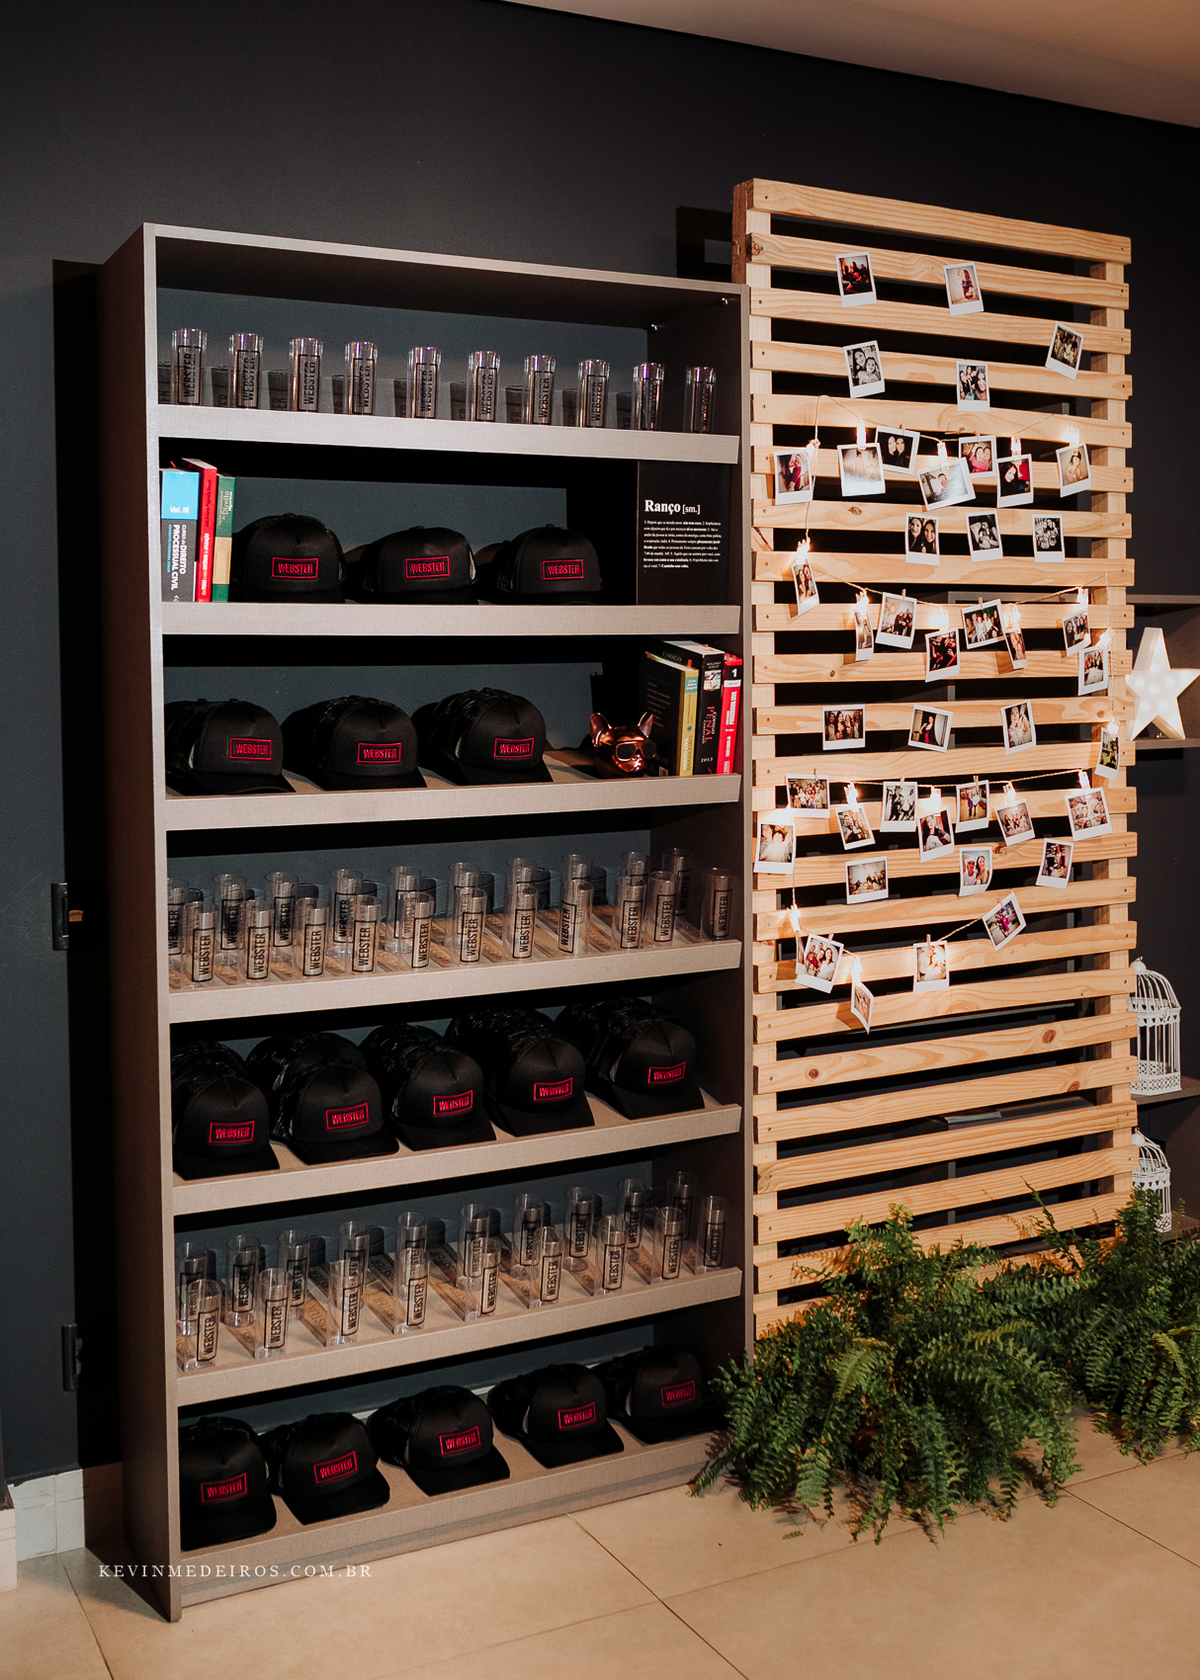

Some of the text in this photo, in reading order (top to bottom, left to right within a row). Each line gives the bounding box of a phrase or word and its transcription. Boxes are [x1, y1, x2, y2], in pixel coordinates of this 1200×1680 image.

[183, 352, 196, 398] WEBSTER
[243, 357, 255, 401] WEBSTER
[303, 361, 316, 405] WEBSTER
[421, 370, 433, 412] WEBSTER
[644, 499, 701, 516] Ranço [sm.]
[171, 524, 180, 591] PROCESSUAL CIVIL
[179, 545, 187, 575] DIREITO
[278, 563, 313, 574] WEBSTER
[411, 561, 446, 574] WEBSTER
[548, 563, 581, 575] WEBSTER
[732, 668, 738, 678] 1
[704, 706, 715, 743] PENAL
[235, 743, 268, 755] WEBSTER
[363, 748, 397, 760] WEBSTER
[499, 743, 530, 755] WEBSTER
[279, 901, 292, 942] WEBSTER
[561, 907, 571, 946] WEBSTER
[626, 905, 639, 943] WEBSTER
[660, 900, 672, 937] WEBSTER
[718, 895, 729, 933] WEBSTER
[310, 929, 322, 970] WEBSTER
[358, 927, 371, 967] WEBSTER
[418, 922, 430, 962] WEBSTER
[466, 917, 479, 957] WEBSTER
[519, 914, 531, 953] WEBSTER
[199, 934, 211, 976] WEBSTER
[253, 932, 266, 974] WEBSTER
[539, 1083, 570, 1098] WEBSTER
[653, 1067, 682, 1081] WEBSTER
[331, 1109, 365, 1125] WEBSTER
[439, 1095, 470, 1111] WEBSTER
[215, 1126, 250, 1139] WEBSTER
[575, 1219, 587, 1253] WEBSTER
[609, 1250, 621, 1285] WEBSTER
[668, 1240, 679, 1274] WEBSTER
[291, 1266, 304, 1303] WEBSTER
[487, 1272, 497, 1308] WEBSTER
[547, 1260, 559, 1296] WEBSTER
[348, 1289, 358, 1330] WEBSTER
[413, 1283, 424, 1320] WEBSTER
[203, 1315, 216, 1355] WEBSTER
[270, 1305, 283, 1343] WEBSTER
[665, 1386, 694, 1401] WEBSTER
[563, 1408, 593, 1424] WEBSTER
[445, 1433, 477, 1450] WEBSTER
[320, 1458, 354, 1479] WEBSTER
[207, 1480, 243, 1498] WEBSTER
